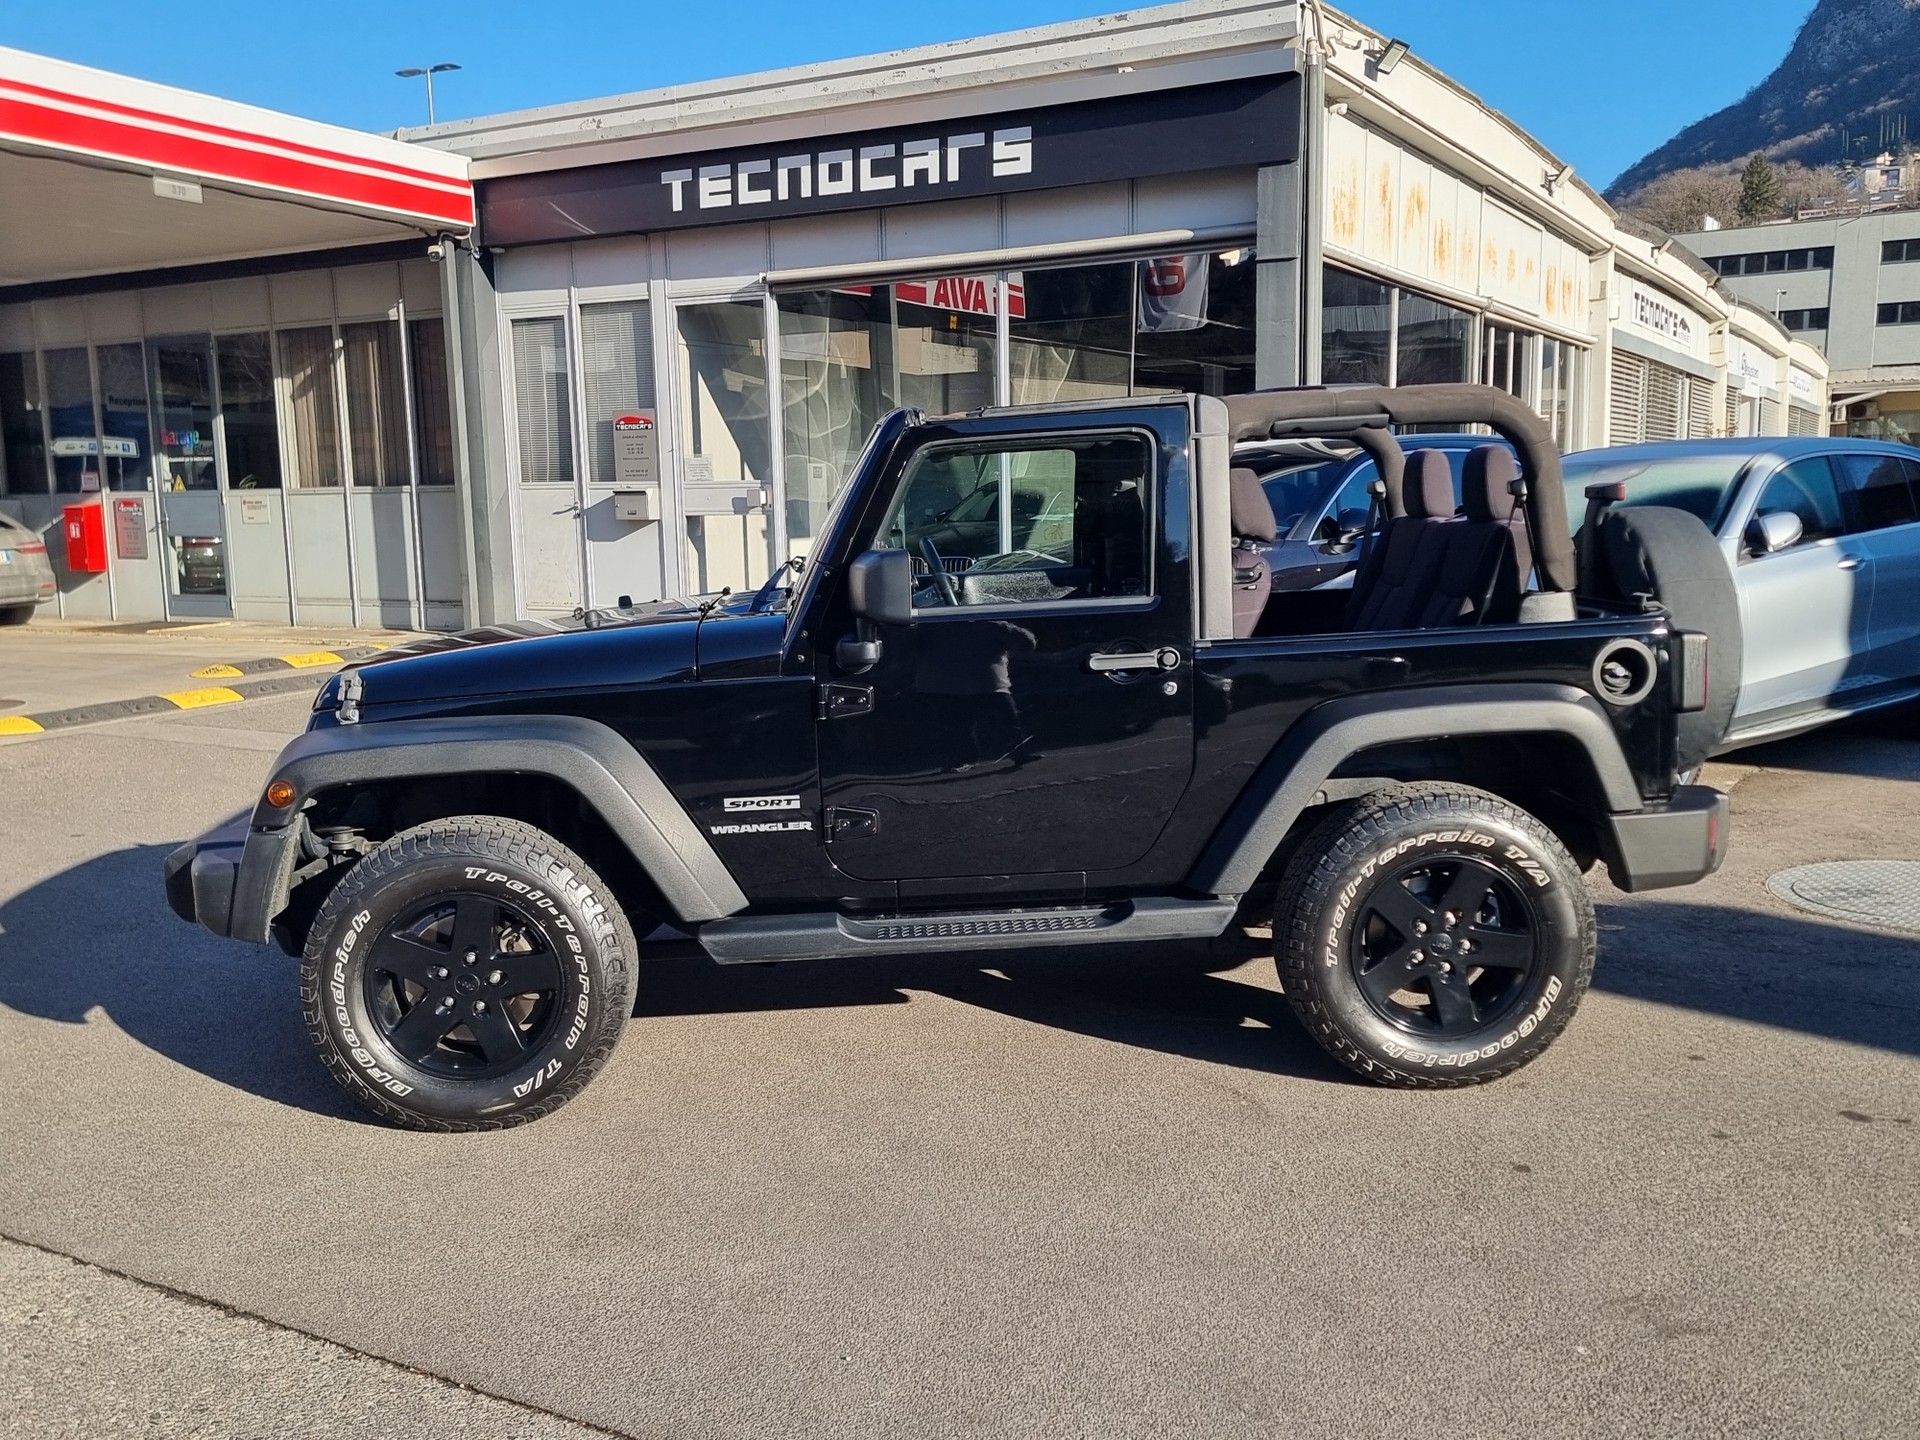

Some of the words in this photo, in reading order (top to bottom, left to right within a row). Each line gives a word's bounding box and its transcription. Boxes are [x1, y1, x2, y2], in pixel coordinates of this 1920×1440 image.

[710, 821, 813, 835] WRANGLER
[728, 797, 797, 810] SPORT
[1326, 830, 1495, 967] Trail-Terrain
[1504, 843, 1551, 887] T/A
[328, 909, 414, 1097] BFGoodrich
[464, 866, 591, 1050] Trail-Terrain
[1381, 975, 1562, 1067] BFGoodrich
[514, 1057, 562, 1098] T/A
